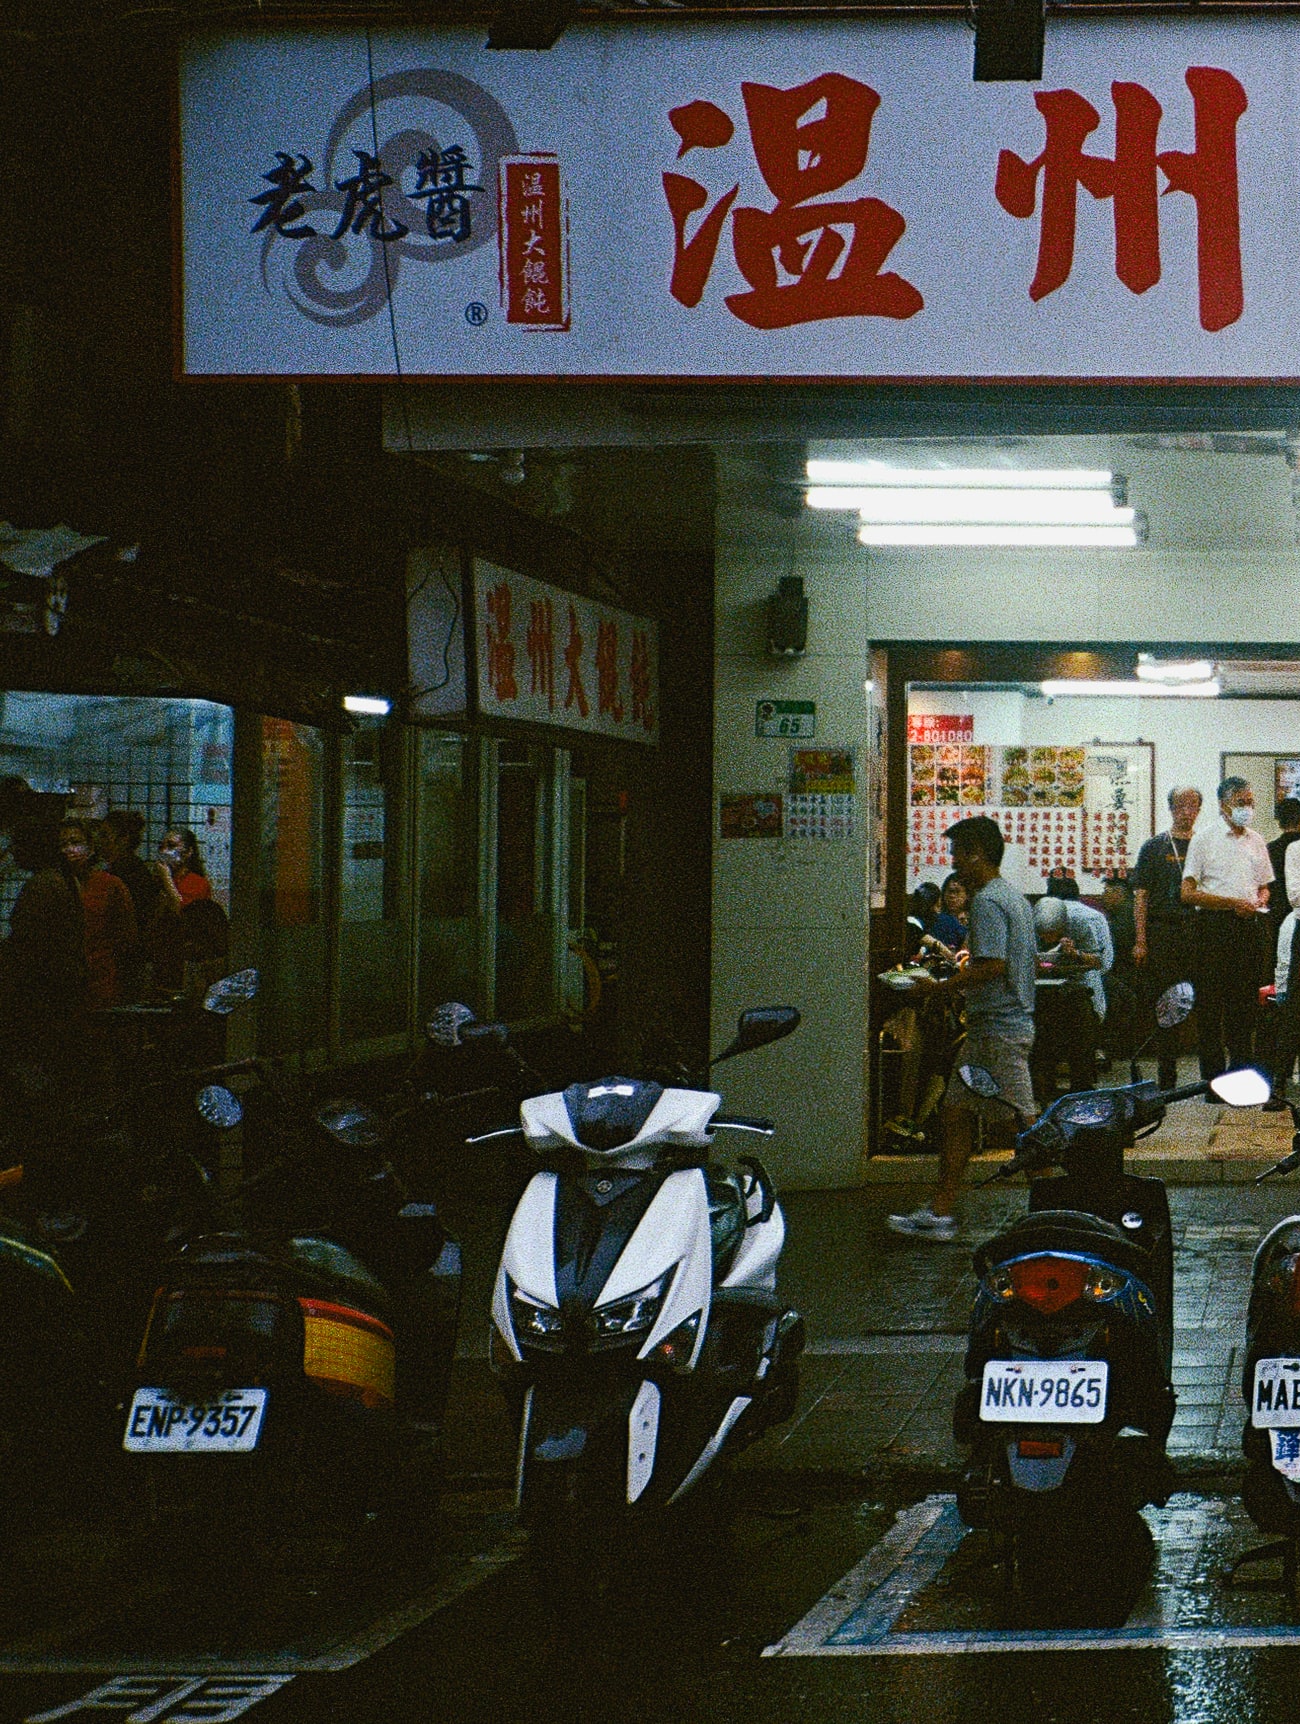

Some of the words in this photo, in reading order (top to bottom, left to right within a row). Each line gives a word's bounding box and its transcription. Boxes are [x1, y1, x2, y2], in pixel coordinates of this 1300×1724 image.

[248, 144, 486, 243] 老虎醬
[779, 718, 801, 734] 65
[985, 1377, 1102, 1409] NKN-9865
[128, 1405, 258, 1438] ENP-9357
